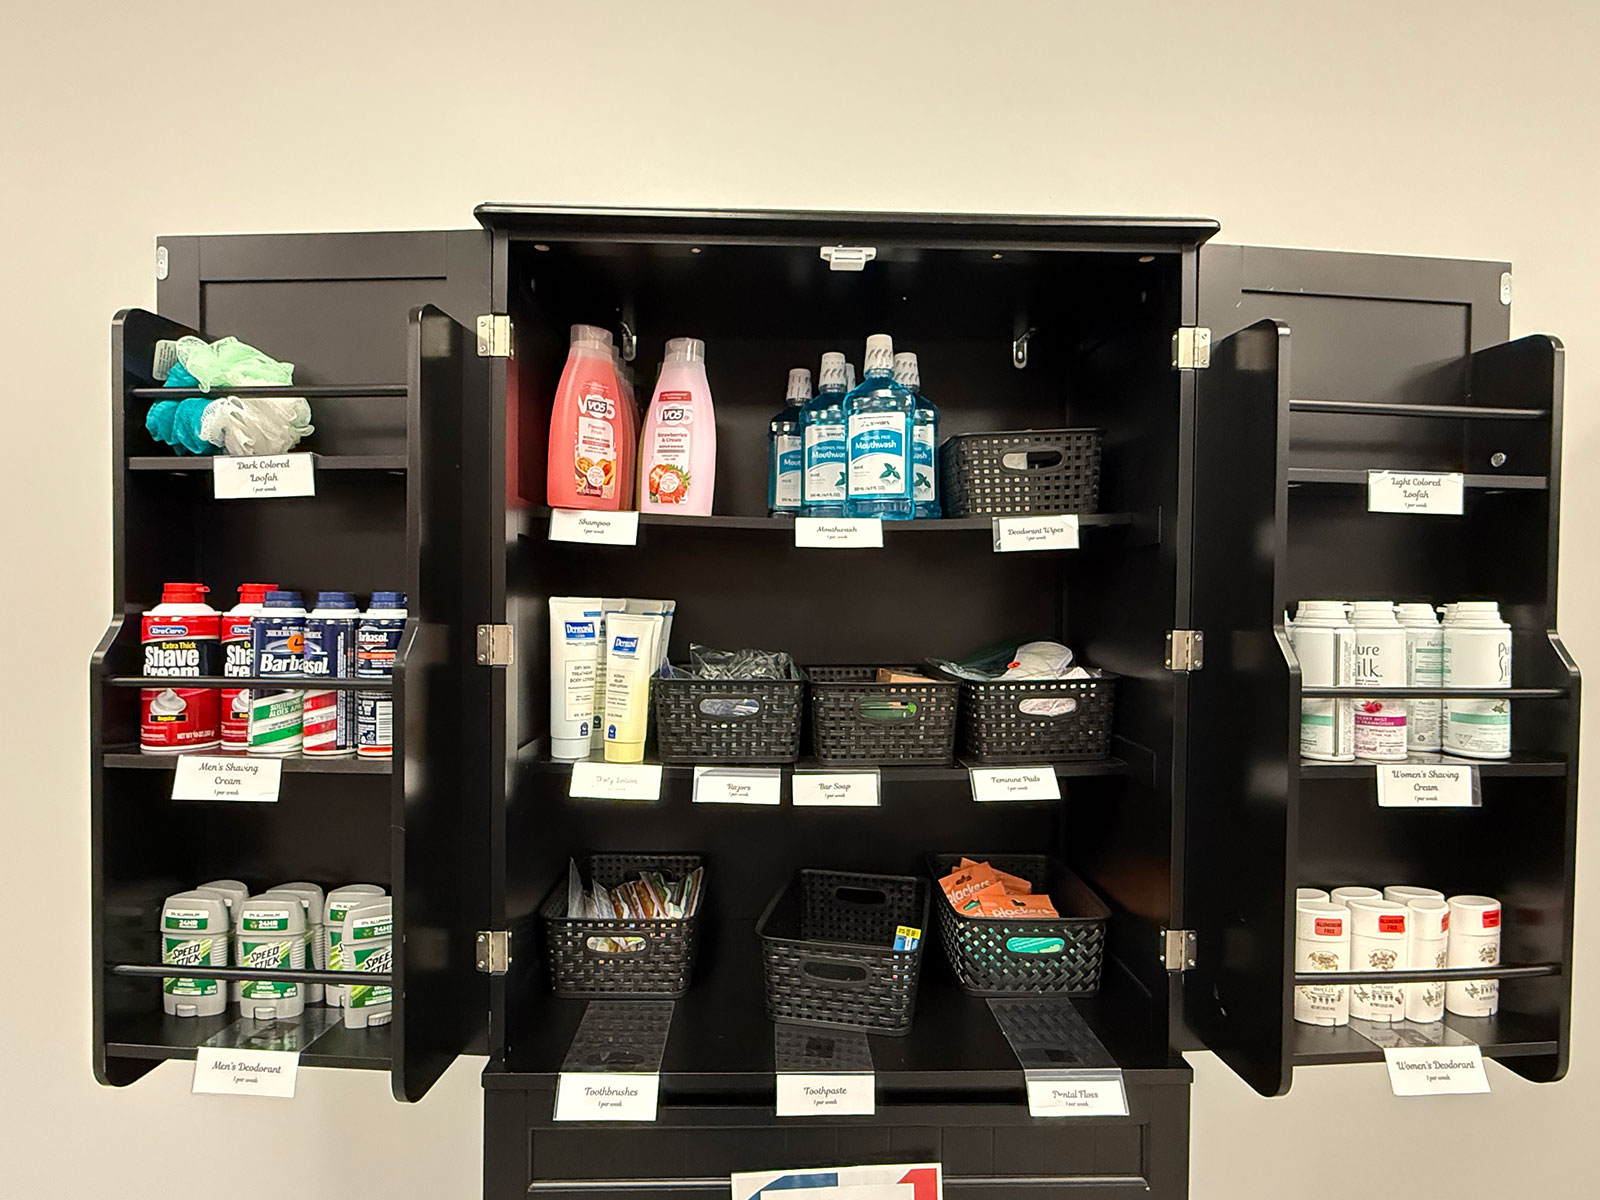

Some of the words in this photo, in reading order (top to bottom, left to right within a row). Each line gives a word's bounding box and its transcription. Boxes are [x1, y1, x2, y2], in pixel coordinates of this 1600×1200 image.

[663, 409, 682, 420] VO5
[855, 440, 896, 450] Mouthwash
[236, 460, 258, 470] Dark
[260, 459, 290, 469] Colored
[250, 472, 278, 485] Loofah
[1390, 478, 1410, 488] Light
[1412, 478, 1441, 486] Colored
[1402, 490, 1428, 501] Loofah
[578, 518, 611, 528] Shampoo
[816, 526, 858, 534] Mouthwash
[1008, 528, 1042, 536] Deodorant
[1043, 527, 1064, 536] Wipes
[145, 646, 199, 666] Shave
[1357, 646, 1380, 656] ure
[1357, 658, 1380, 678] ilk
[198, 763, 222, 772] Men's
[225, 764, 259, 775] Shaving
[214, 776, 242, 786] Cream
[990, 776, 1021, 784] Feminine
[1392, 770, 1426, 780] Women's
[1428, 770, 1460, 782] Shaving
[727, 783, 751, 792] Razors
[833, 783, 851, 792] Soap
[1413, 783, 1438, 792] Cream
[172, 944, 200, 960] SPEED
[250, 946, 280, 963] SPEED
[176, 952, 200, 966] STICK
[255, 955, 280, 968] STICK
[364, 950, 392, 970] SPEE
[212, 1061, 236, 1071] Men's
[238, 1062, 282, 1074] Deodorant
[1396, 1060, 1432, 1071] Women's
[1434, 1060, 1475, 1070] Deodorant
[584, 1086, 638, 1097] Toothbrushes
[804, 1086, 847, 1098] Toothpaste
[1078, 1090, 1099, 1099] Floss
